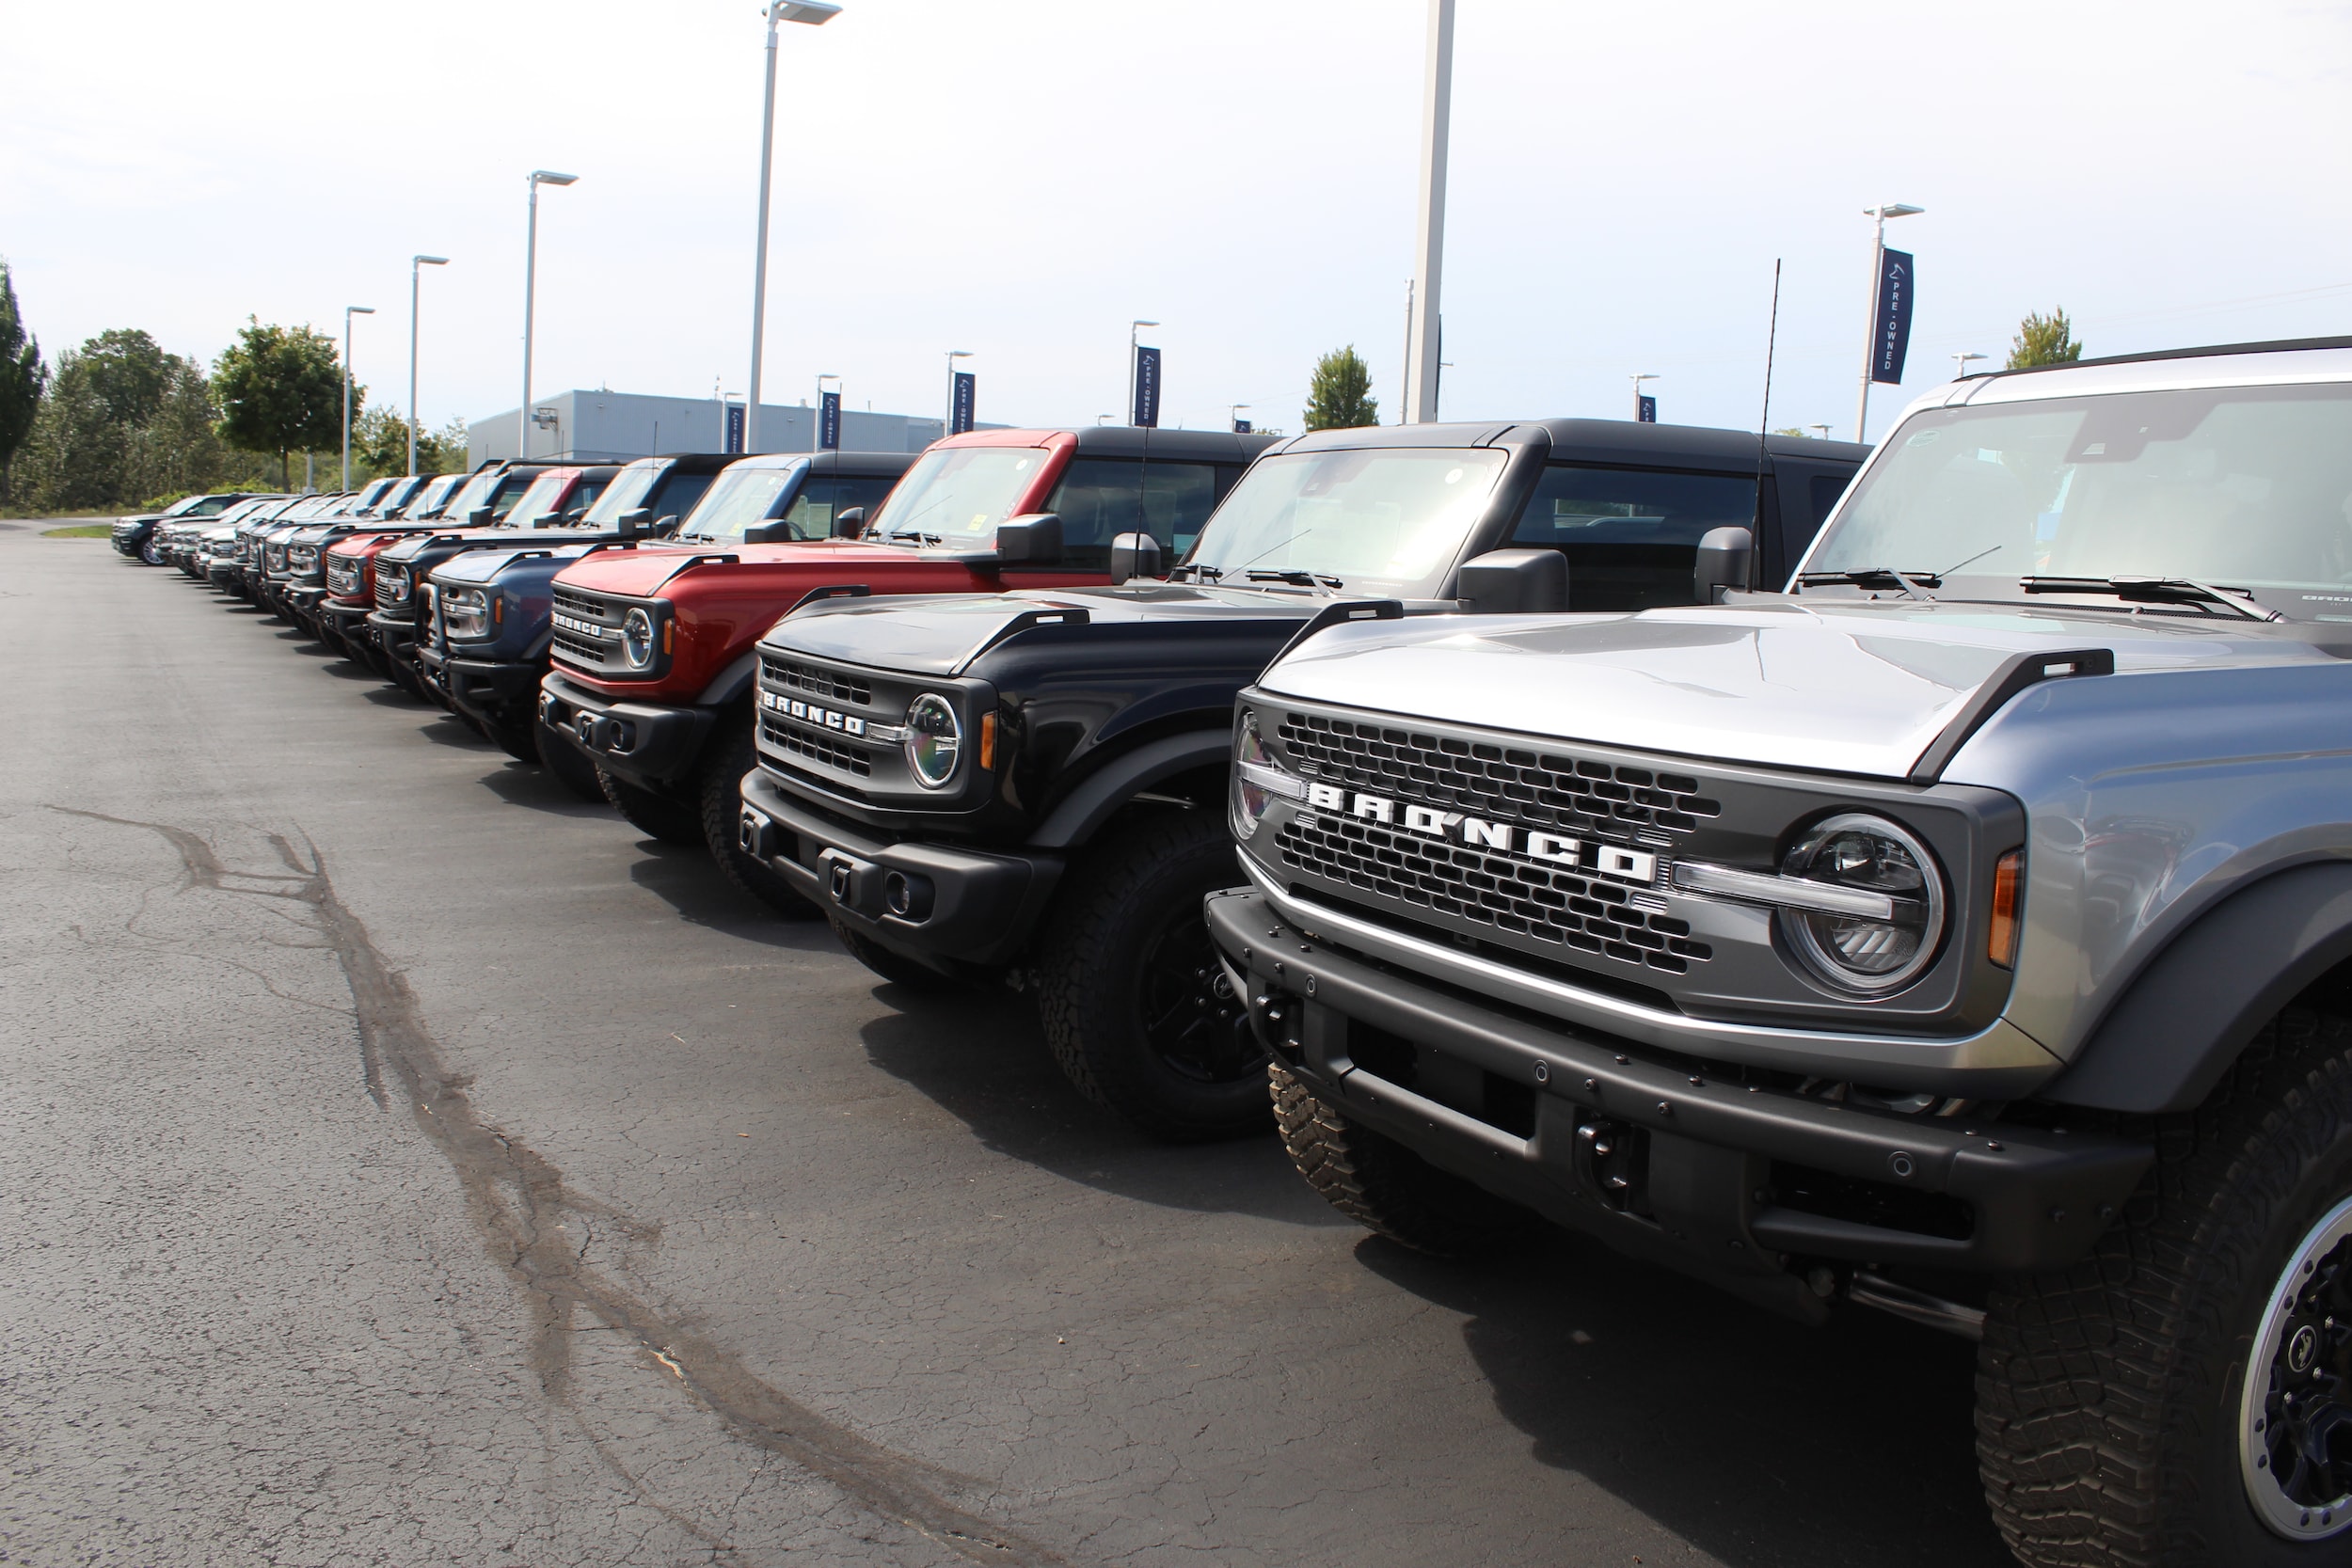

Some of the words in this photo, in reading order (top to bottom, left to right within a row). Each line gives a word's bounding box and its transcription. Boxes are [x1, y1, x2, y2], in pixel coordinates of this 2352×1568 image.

[553, 611, 602, 637] BRONCO
[763, 691, 866, 736] BRONCO
[1308, 782, 1658, 882] BRONCO
